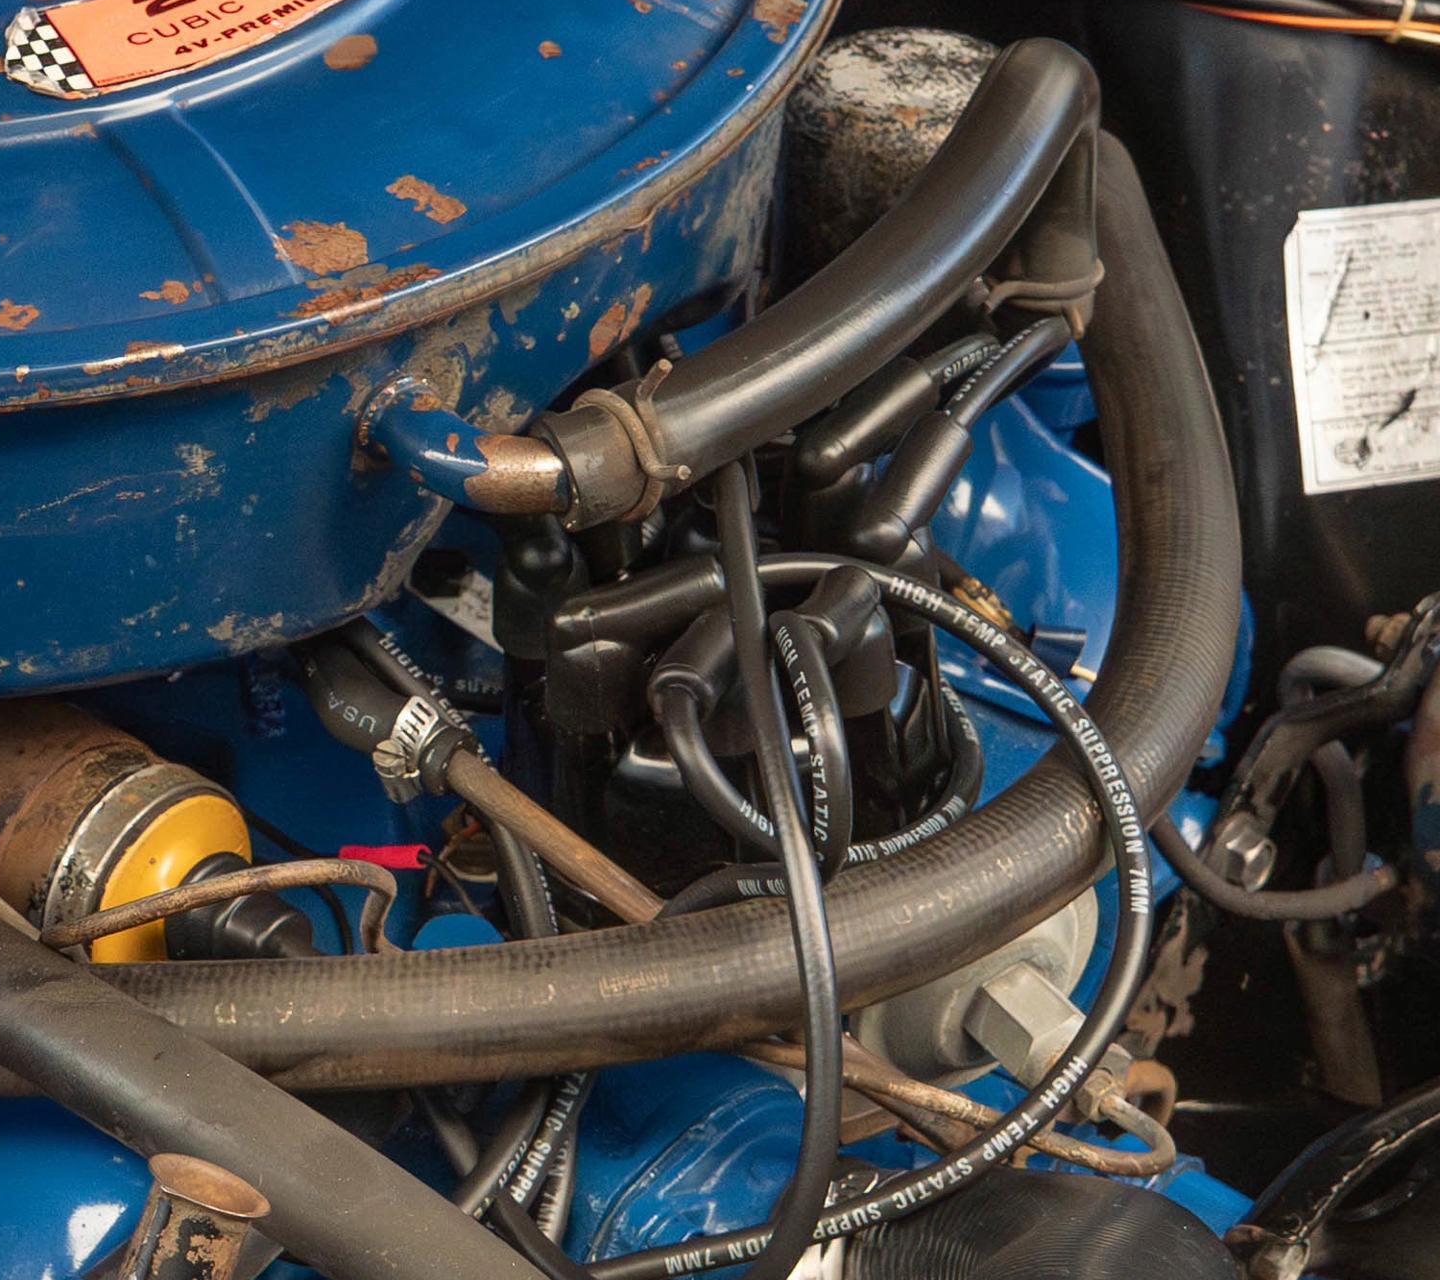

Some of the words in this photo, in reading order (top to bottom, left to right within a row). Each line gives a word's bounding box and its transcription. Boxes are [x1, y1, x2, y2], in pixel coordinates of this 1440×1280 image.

[128, 0, 244, 47] CUBIC
[776, 626, 799, 669] HIGH
[792, 671, 819, 738] TEMP
[809, 752, 829, 843] STATIC
[889, 577, 941, 613] HIGH
[952, 609, 1008, 649] TEMP
[1071, 717, 1144, 855] SUPPRESSION
[1128, 867, 1150, 915] 7MM
[544, 1073, 587, 1133] TATIC
[1041, 1055, 1088, 1110] HIGH
[982, 1114, 1040, 1163] TEMP
[892, 1160, 975, 1210] STATIC
[665, 1248, 717, 1275] 7MM
